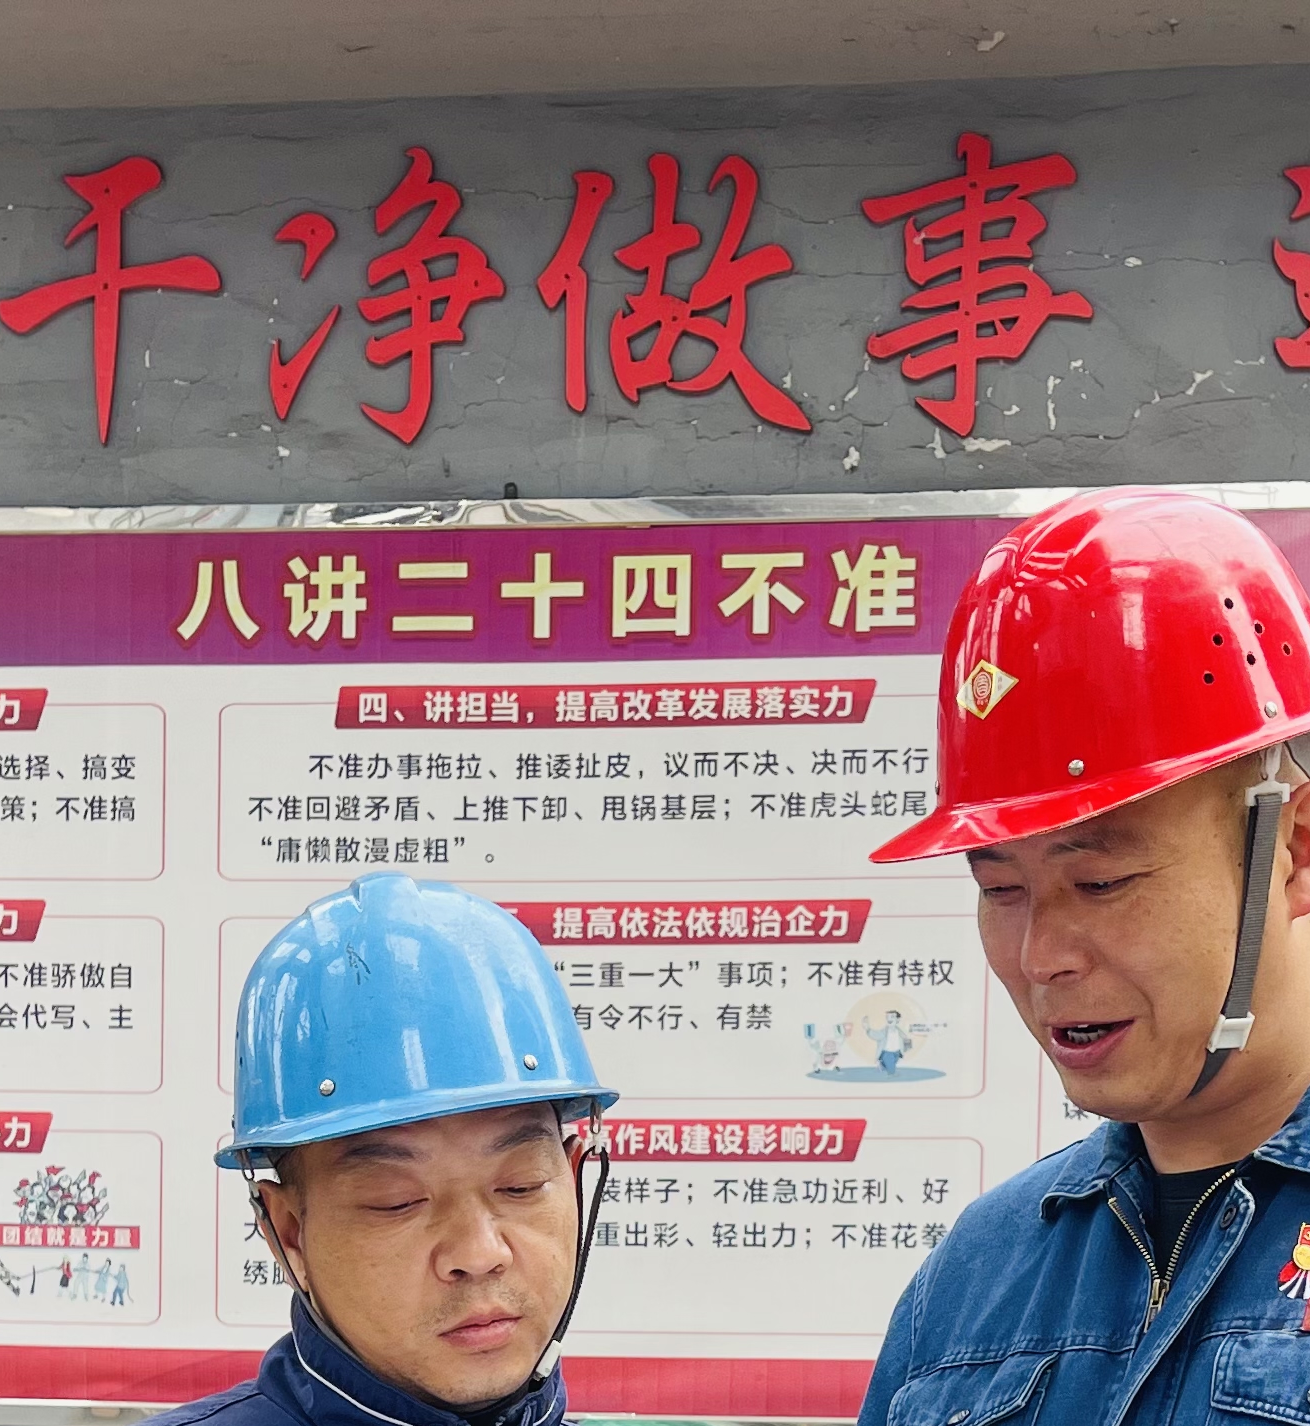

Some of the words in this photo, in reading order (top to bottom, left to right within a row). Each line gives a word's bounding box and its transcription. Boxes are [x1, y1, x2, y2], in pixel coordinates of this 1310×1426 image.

[176, 543, 919, 643] 八讲二十四不准
[358, 685, 854, 724] 四、讲担当，提高改革发展落实力
[308, 747, 930, 780] 不准办事拖拉、推诿扯皮，议而不决、决而不行
[247, 790, 928, 823] 不准回避矛盾、上推下卸、甩锅基层；不准虎头蛇尾
[552, 905, 850, 939] 提高依法依规治企力
[572, 1003, 773, 1031] 有令不行、有禁
[561, 1120, 844, 1157] 高作风建设影响力
[2, 1226, 132, 1248] 团结就是力量
